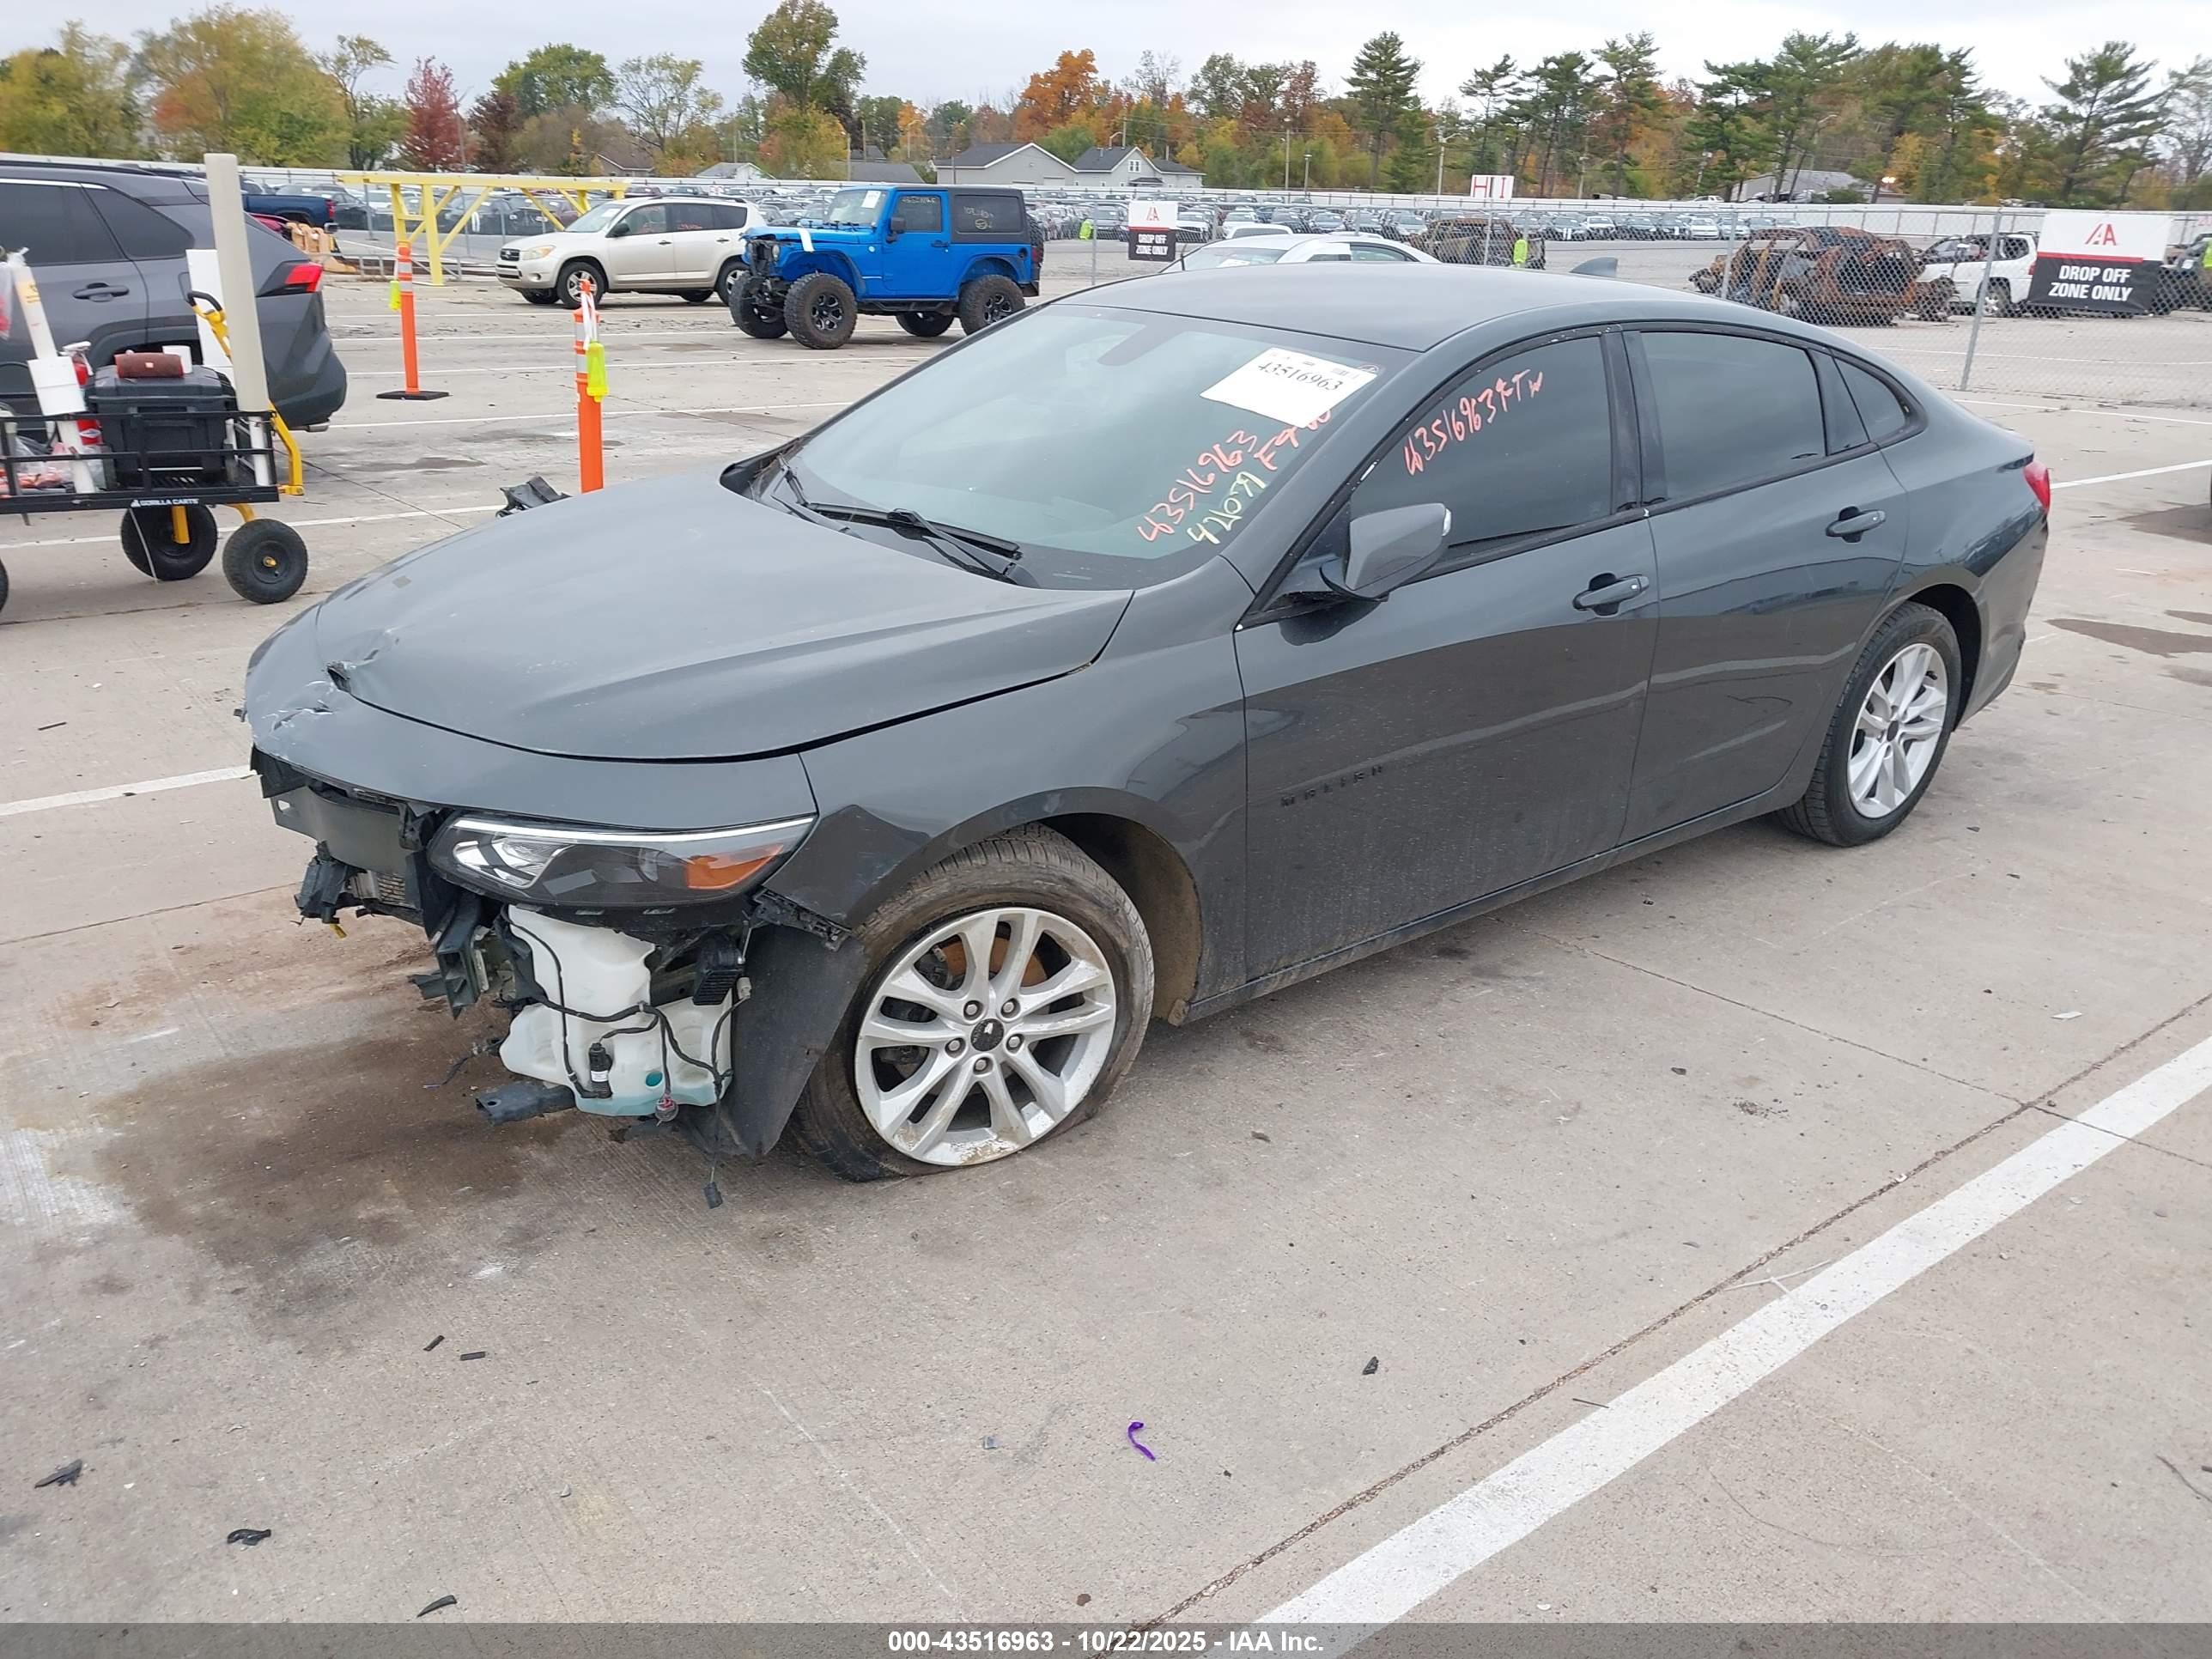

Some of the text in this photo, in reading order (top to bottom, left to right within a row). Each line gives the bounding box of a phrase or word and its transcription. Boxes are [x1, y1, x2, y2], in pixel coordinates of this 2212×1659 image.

[1135, 245, 1168, 255] ZONE ONLY
[2059, 264, 2131, 283] DROP OFF
[2048, 282, 2133, 301] ZONE ONLY
[1258, 362, 1344, 391] 43516963
[1137, 429, 1258, 542] 43516963
